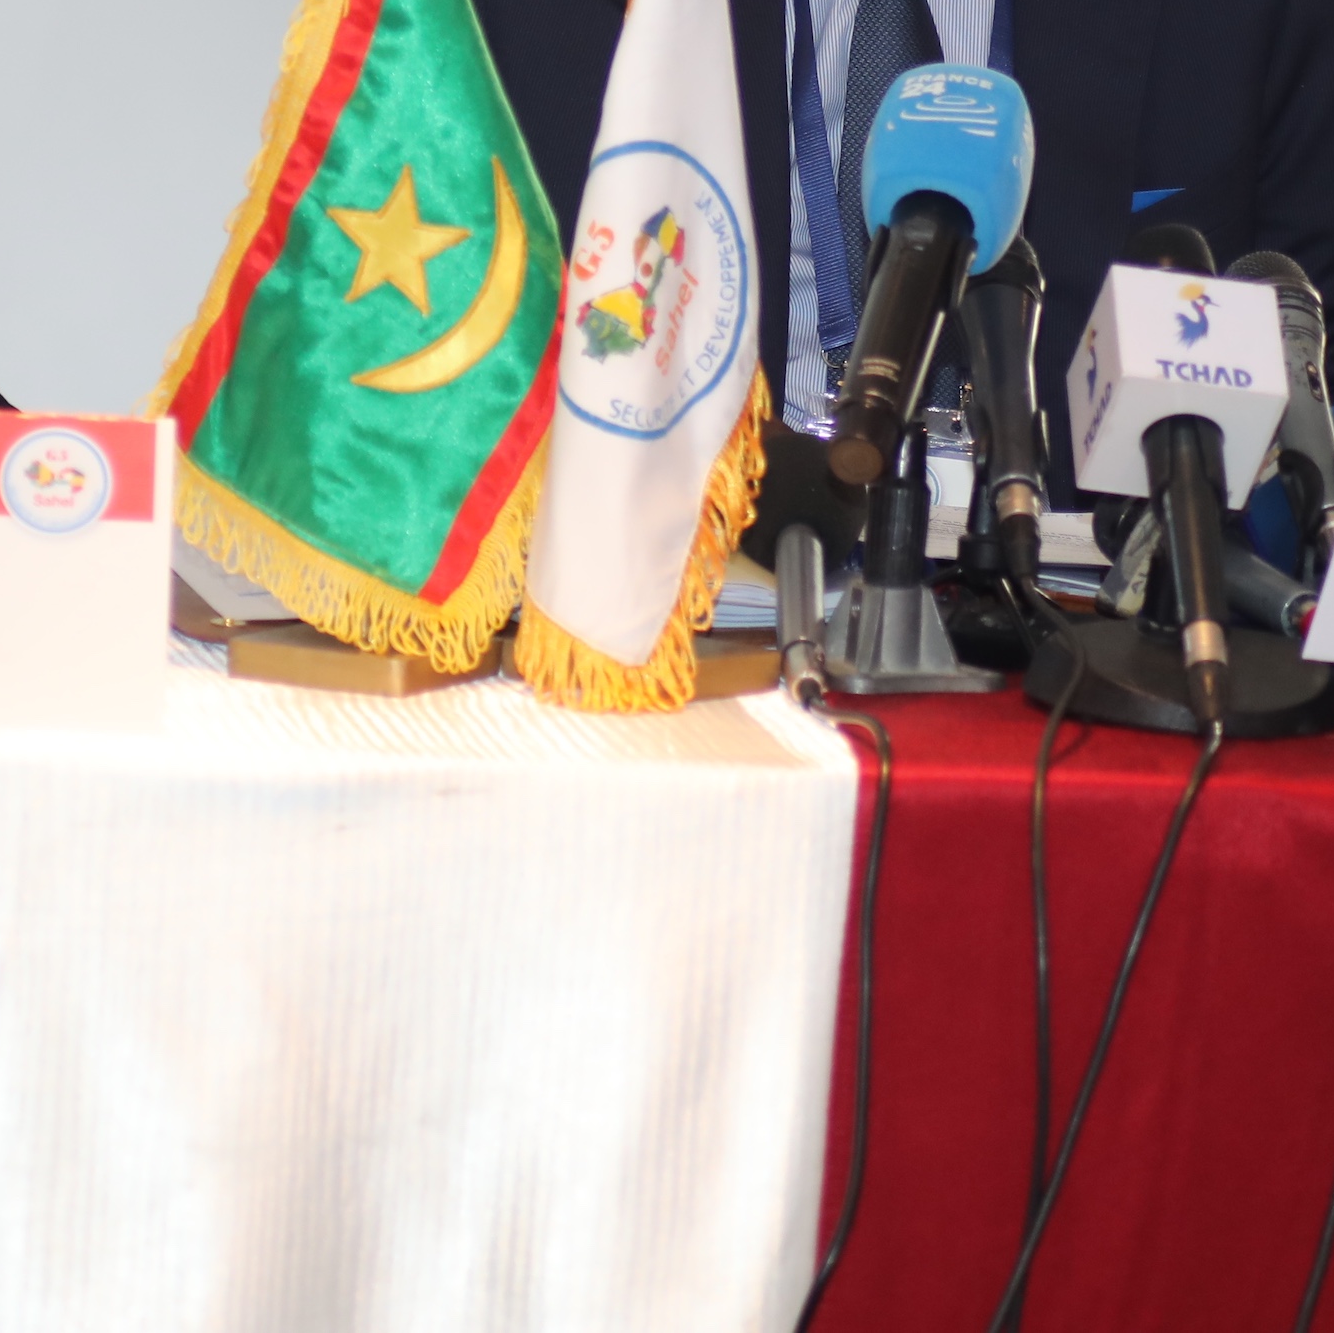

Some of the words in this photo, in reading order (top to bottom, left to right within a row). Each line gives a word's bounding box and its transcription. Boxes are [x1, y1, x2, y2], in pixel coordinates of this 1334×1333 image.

[899, 81, 946, 99] 24
[905, 74, 993, 91] FRANCE
[572, 220, 615, 281] G5
[1155, 358, 1253, 388] TCHAD
[1084, 381, 1112, 456] TCHAD
